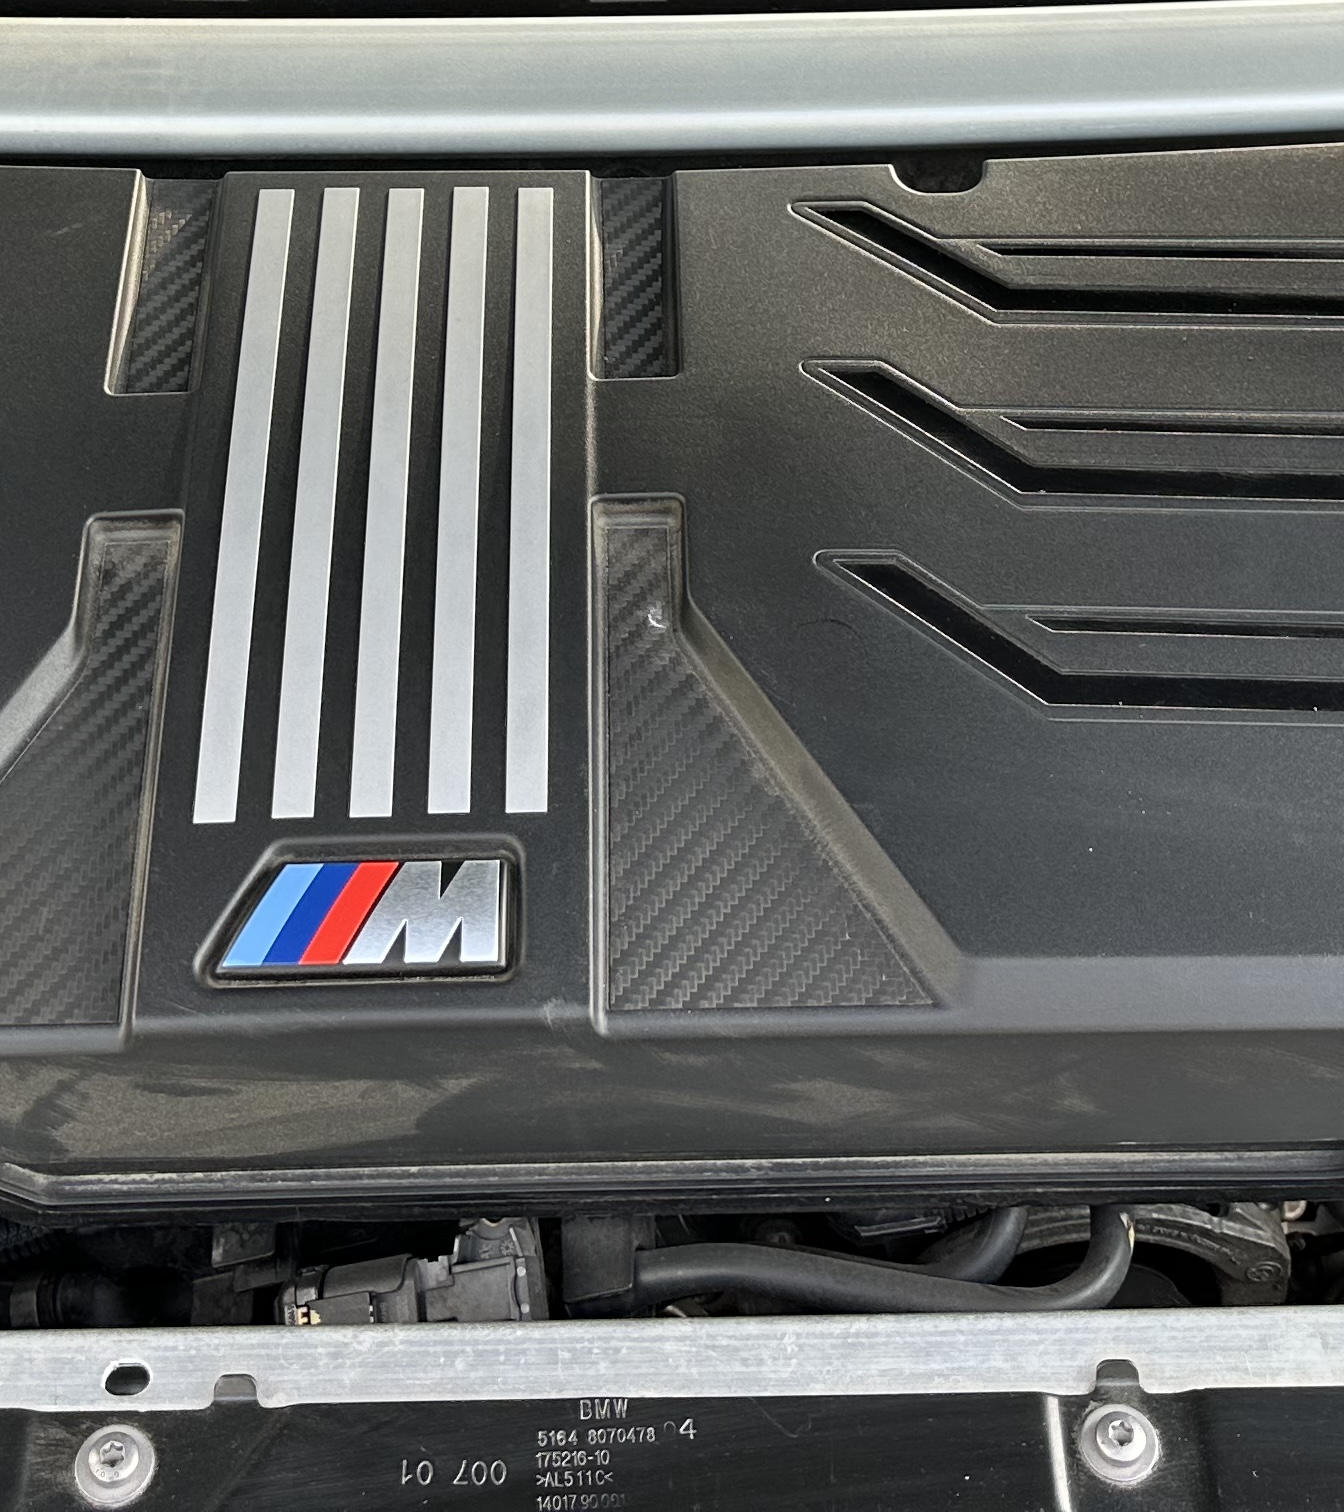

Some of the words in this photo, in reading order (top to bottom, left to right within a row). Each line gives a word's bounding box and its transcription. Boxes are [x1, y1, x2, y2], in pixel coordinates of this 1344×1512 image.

[343, 859, 501, 965] M
[579, 1397, 629, 1420] BMW
[537, 1429, 578, 1447] 5164
[587, 1426, 656, 1445] 8070478
[535, 1449, 610, 1469] 175216-10
